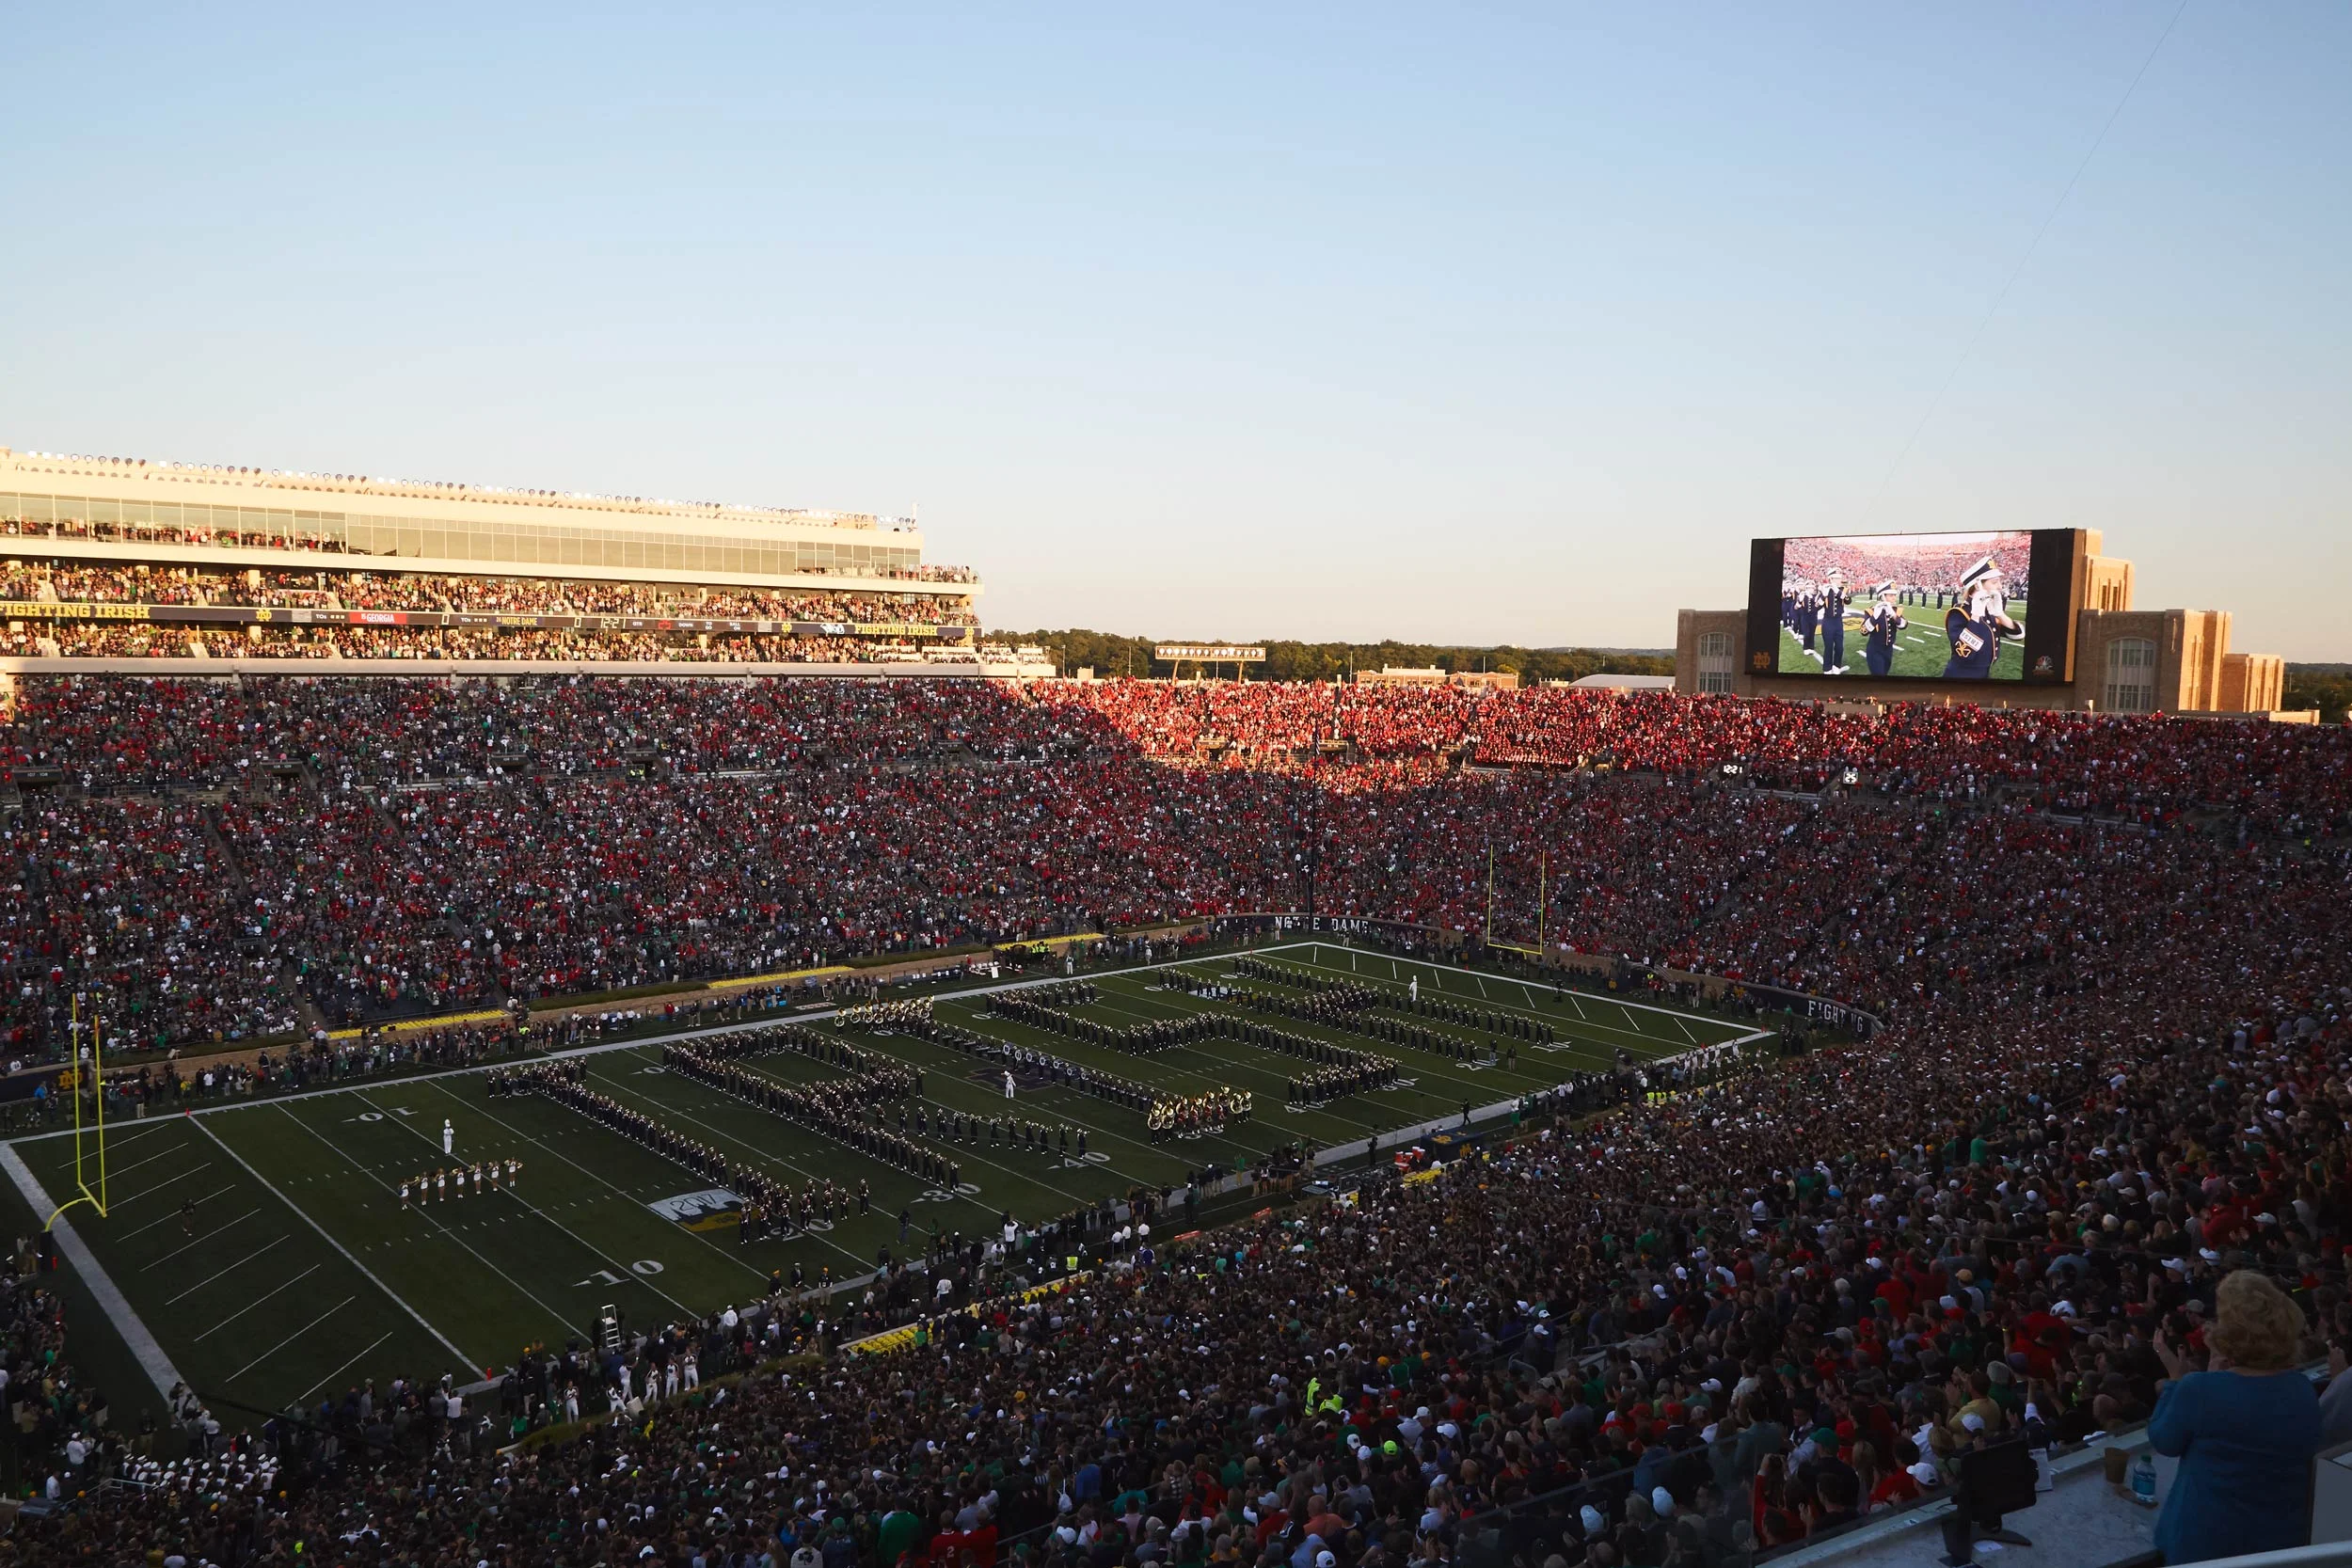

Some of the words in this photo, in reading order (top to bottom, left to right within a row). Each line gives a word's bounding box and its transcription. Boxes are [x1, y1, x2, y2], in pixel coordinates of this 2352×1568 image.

[95, 606, 151, 619] IRISH
[366, 613, 395, 623] GEORGIA
[521, 617, 538, 626] DAME
[854, 625, 905, 635] FIGHTING
[907, 626, 938, 636] IRISH
[1275, 916, 1321, 930] NOTE
[1807, 1000, 1864, 1033] FIGHTNG
[1064, 1151, 1111, 1168] 40
[922, 1182, 981, 1202] 30
[770, 1218, 834, 1243] 20
[589, 1259, 664, 1287] 10
